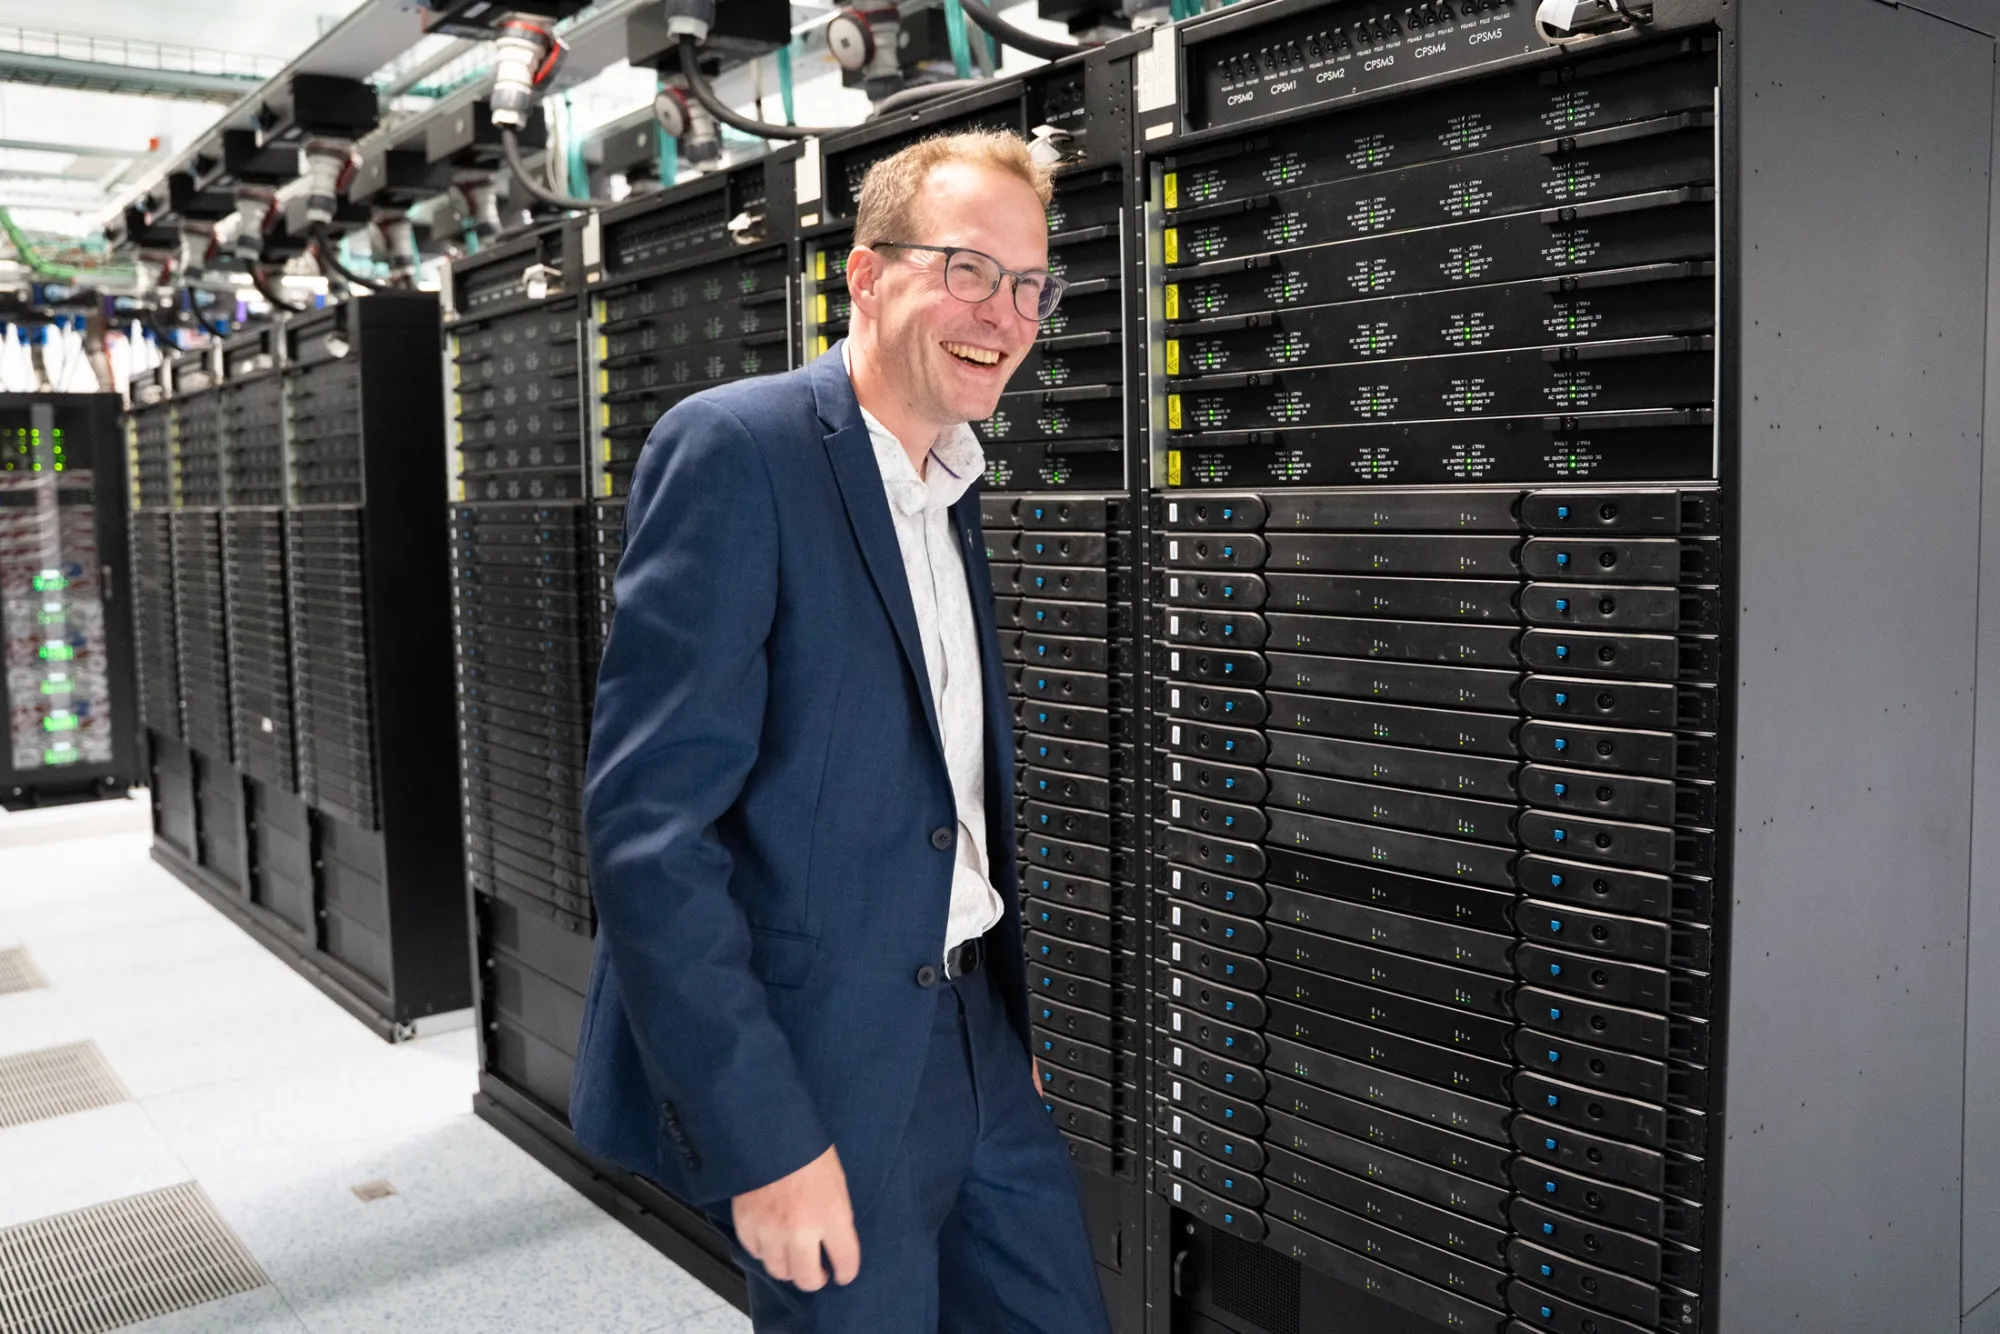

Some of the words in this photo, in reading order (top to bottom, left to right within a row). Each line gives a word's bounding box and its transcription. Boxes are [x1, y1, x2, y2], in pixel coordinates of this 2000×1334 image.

[1469, 28, 1502, 45] CPSM5
[1415, 42, 1446, 58] CPSM4
[1364, 56, 1394, 71] CPSM3
[1316, 68, 1344, 83] CPSM2
[1271, 80, 1296, 94] CPSM1
[1228, 91, 1253, 105] CPSM0
